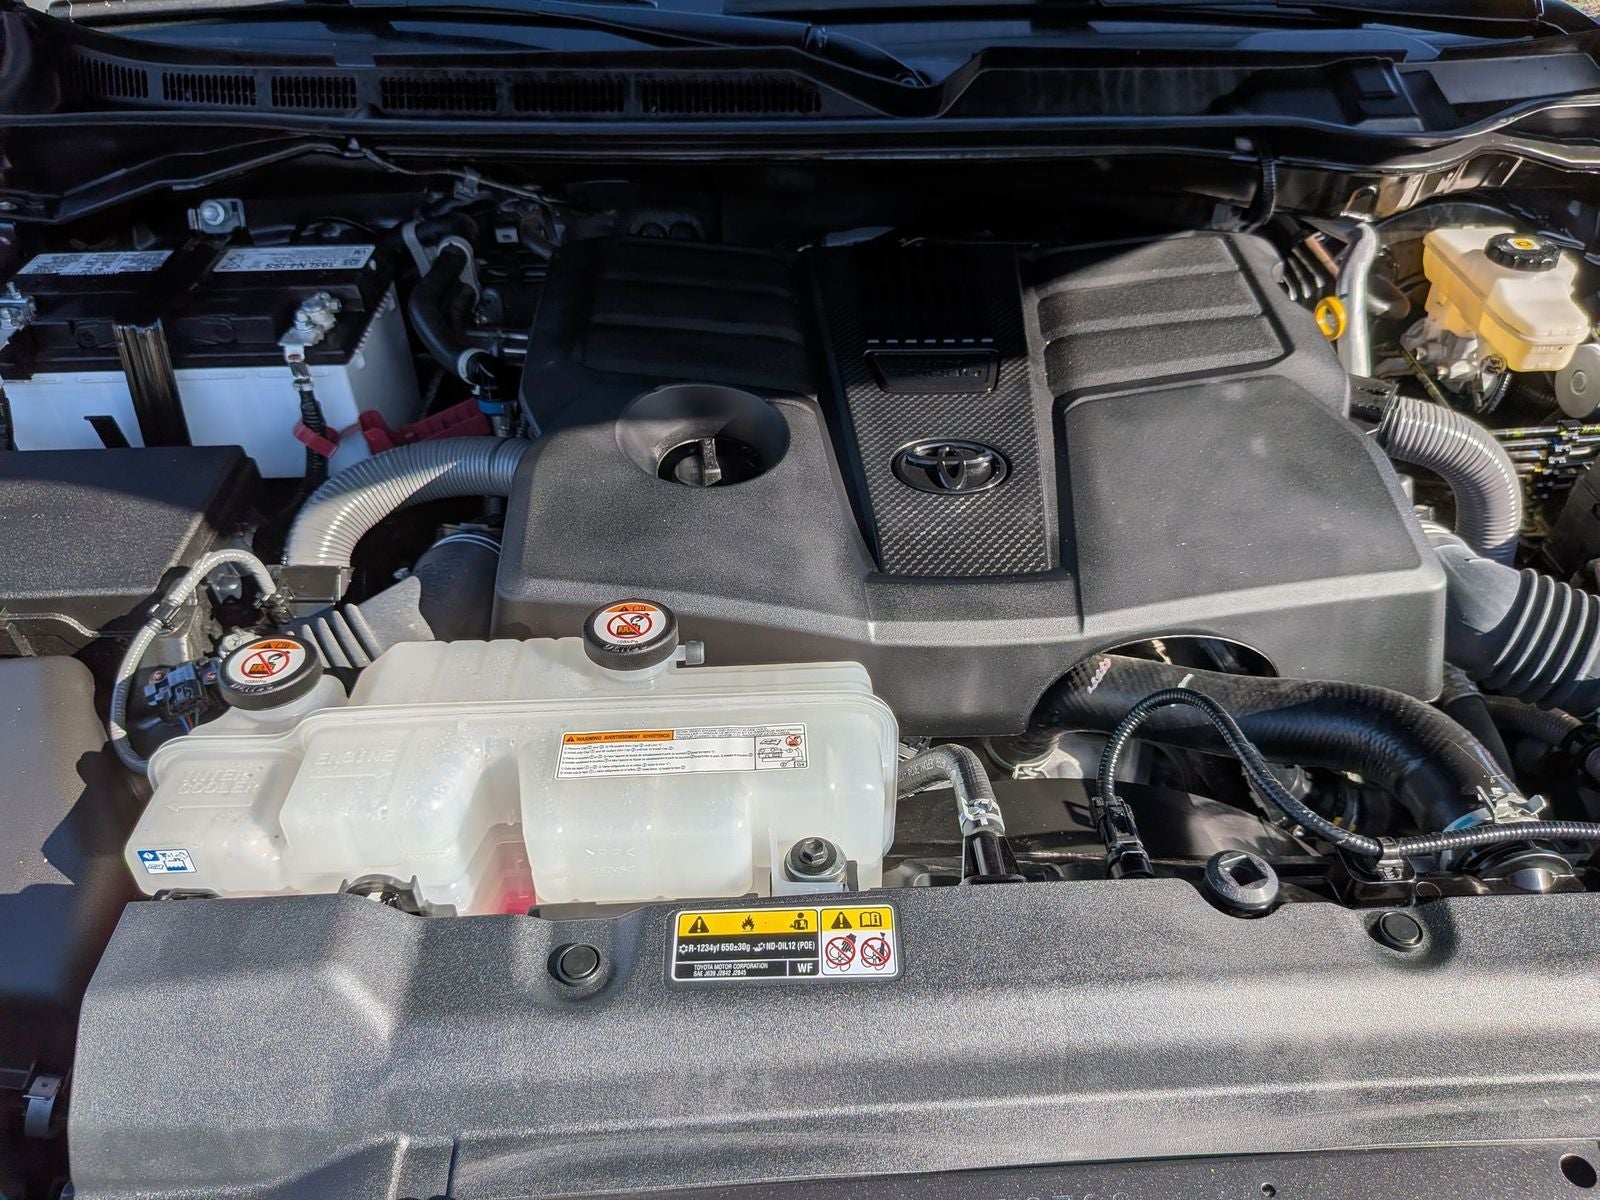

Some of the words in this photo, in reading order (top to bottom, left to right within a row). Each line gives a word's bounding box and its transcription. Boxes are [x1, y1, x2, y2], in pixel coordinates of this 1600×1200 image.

[315, 751, 397, 766] ENGINE
[177, 780, 261, 795] COOLER
[688, 943, 719, 954] R-1234yf
[721, 942, 751, 953] 650±30g
[766, 941, 796, 951] ND-OIL12
[797, 940, 816, 951] (POE)
[694, 963, 713, 971] TOYOTA
[732, 962, 768, 970] CORPORATION
[797, 963, 813, 973] WF
